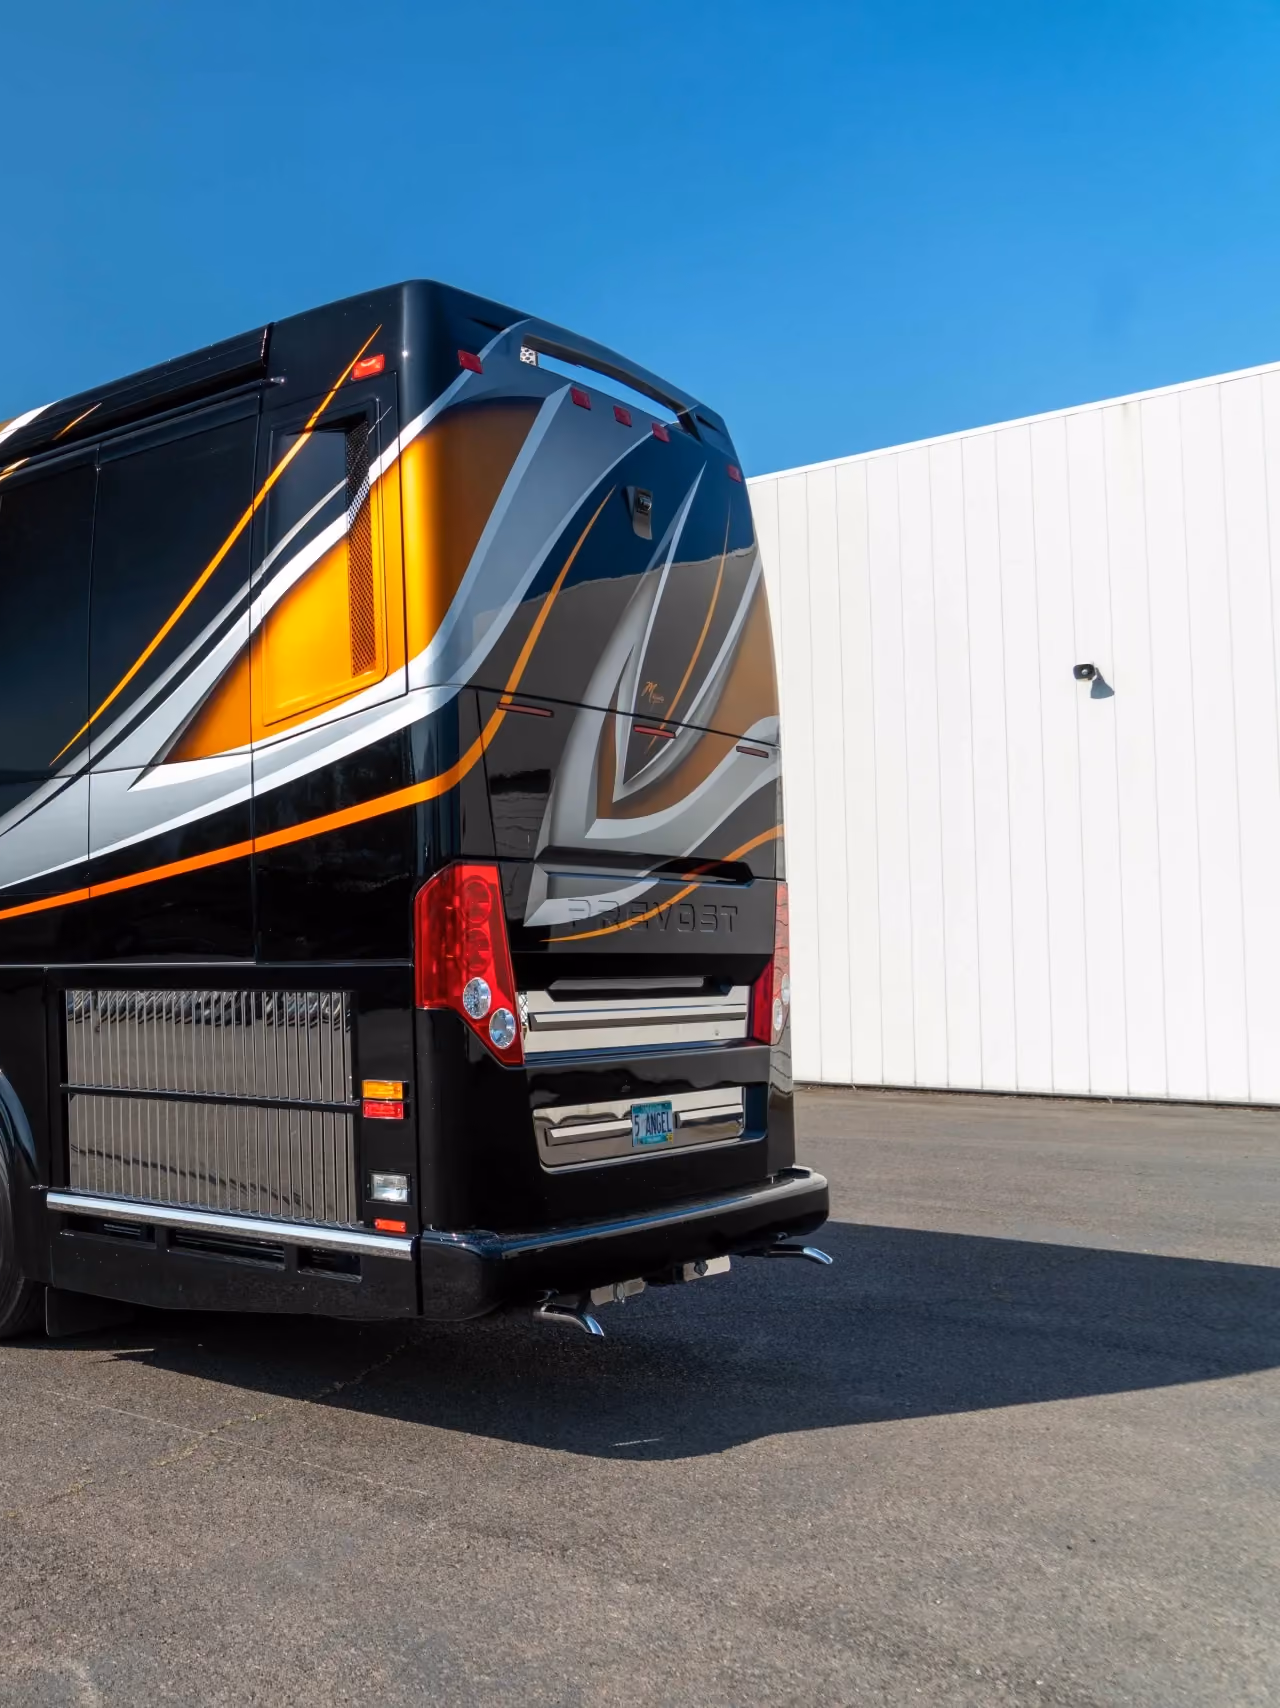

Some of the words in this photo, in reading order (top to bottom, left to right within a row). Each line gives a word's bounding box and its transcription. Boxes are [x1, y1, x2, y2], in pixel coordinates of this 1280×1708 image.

[567, 899, 738, 933] PREVOST
[634, 1114, 640, 1137] 5
[645, 1111, 672, 1137] ANGEL
